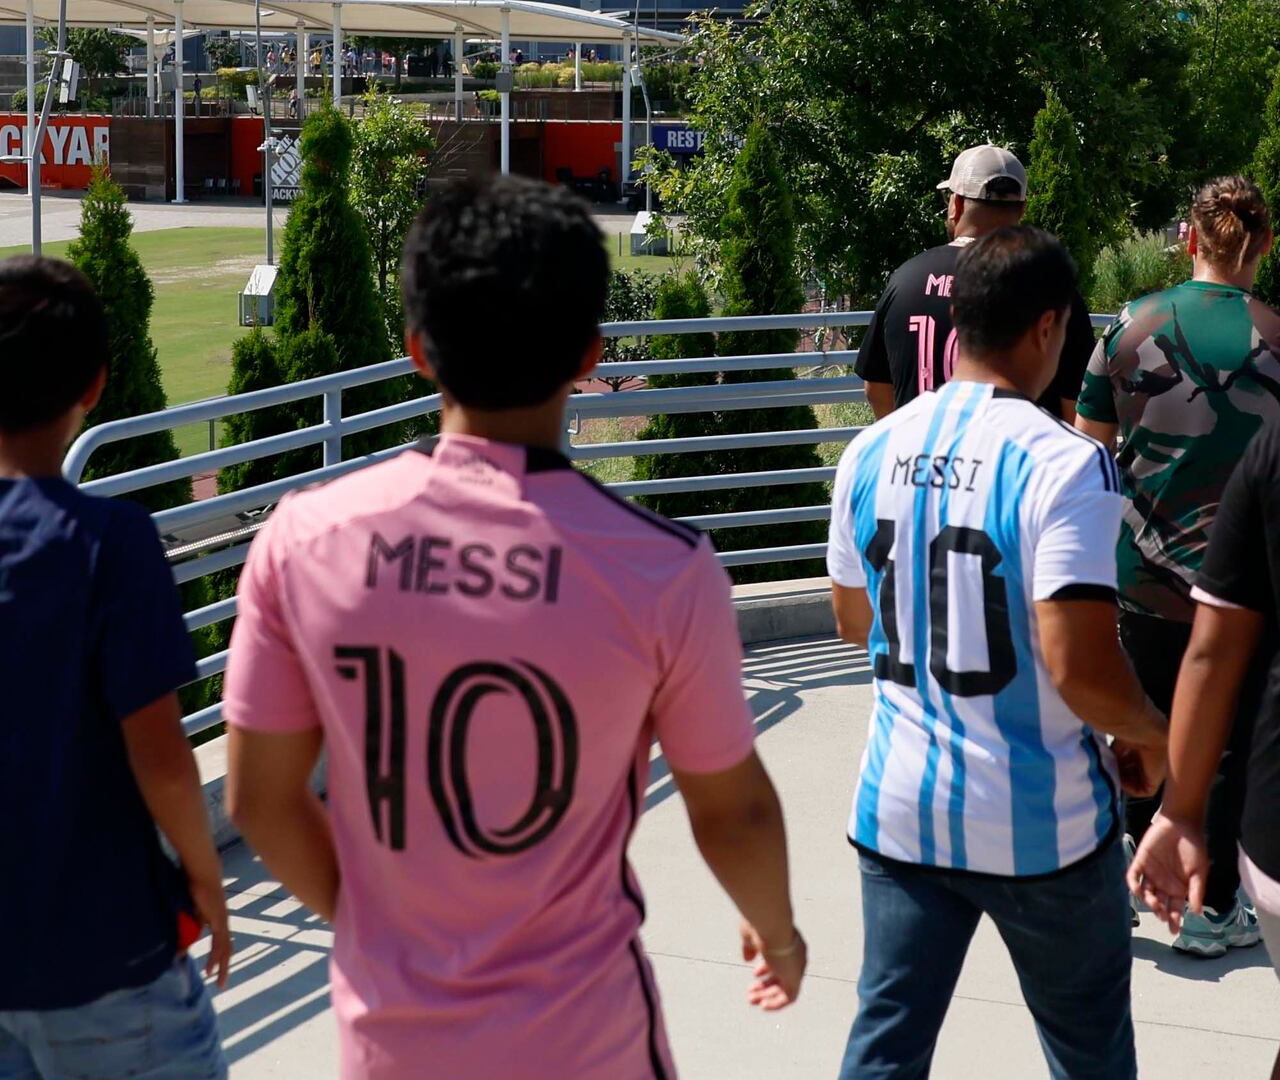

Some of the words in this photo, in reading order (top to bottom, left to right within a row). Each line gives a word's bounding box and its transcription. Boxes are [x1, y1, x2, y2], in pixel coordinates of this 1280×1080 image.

[890, 453, 983, 492] MESSI
[365, 530, 563, 605] MESSI
[865, 518, 1018, 698] 10
[333, 643, 580, 862] 10
